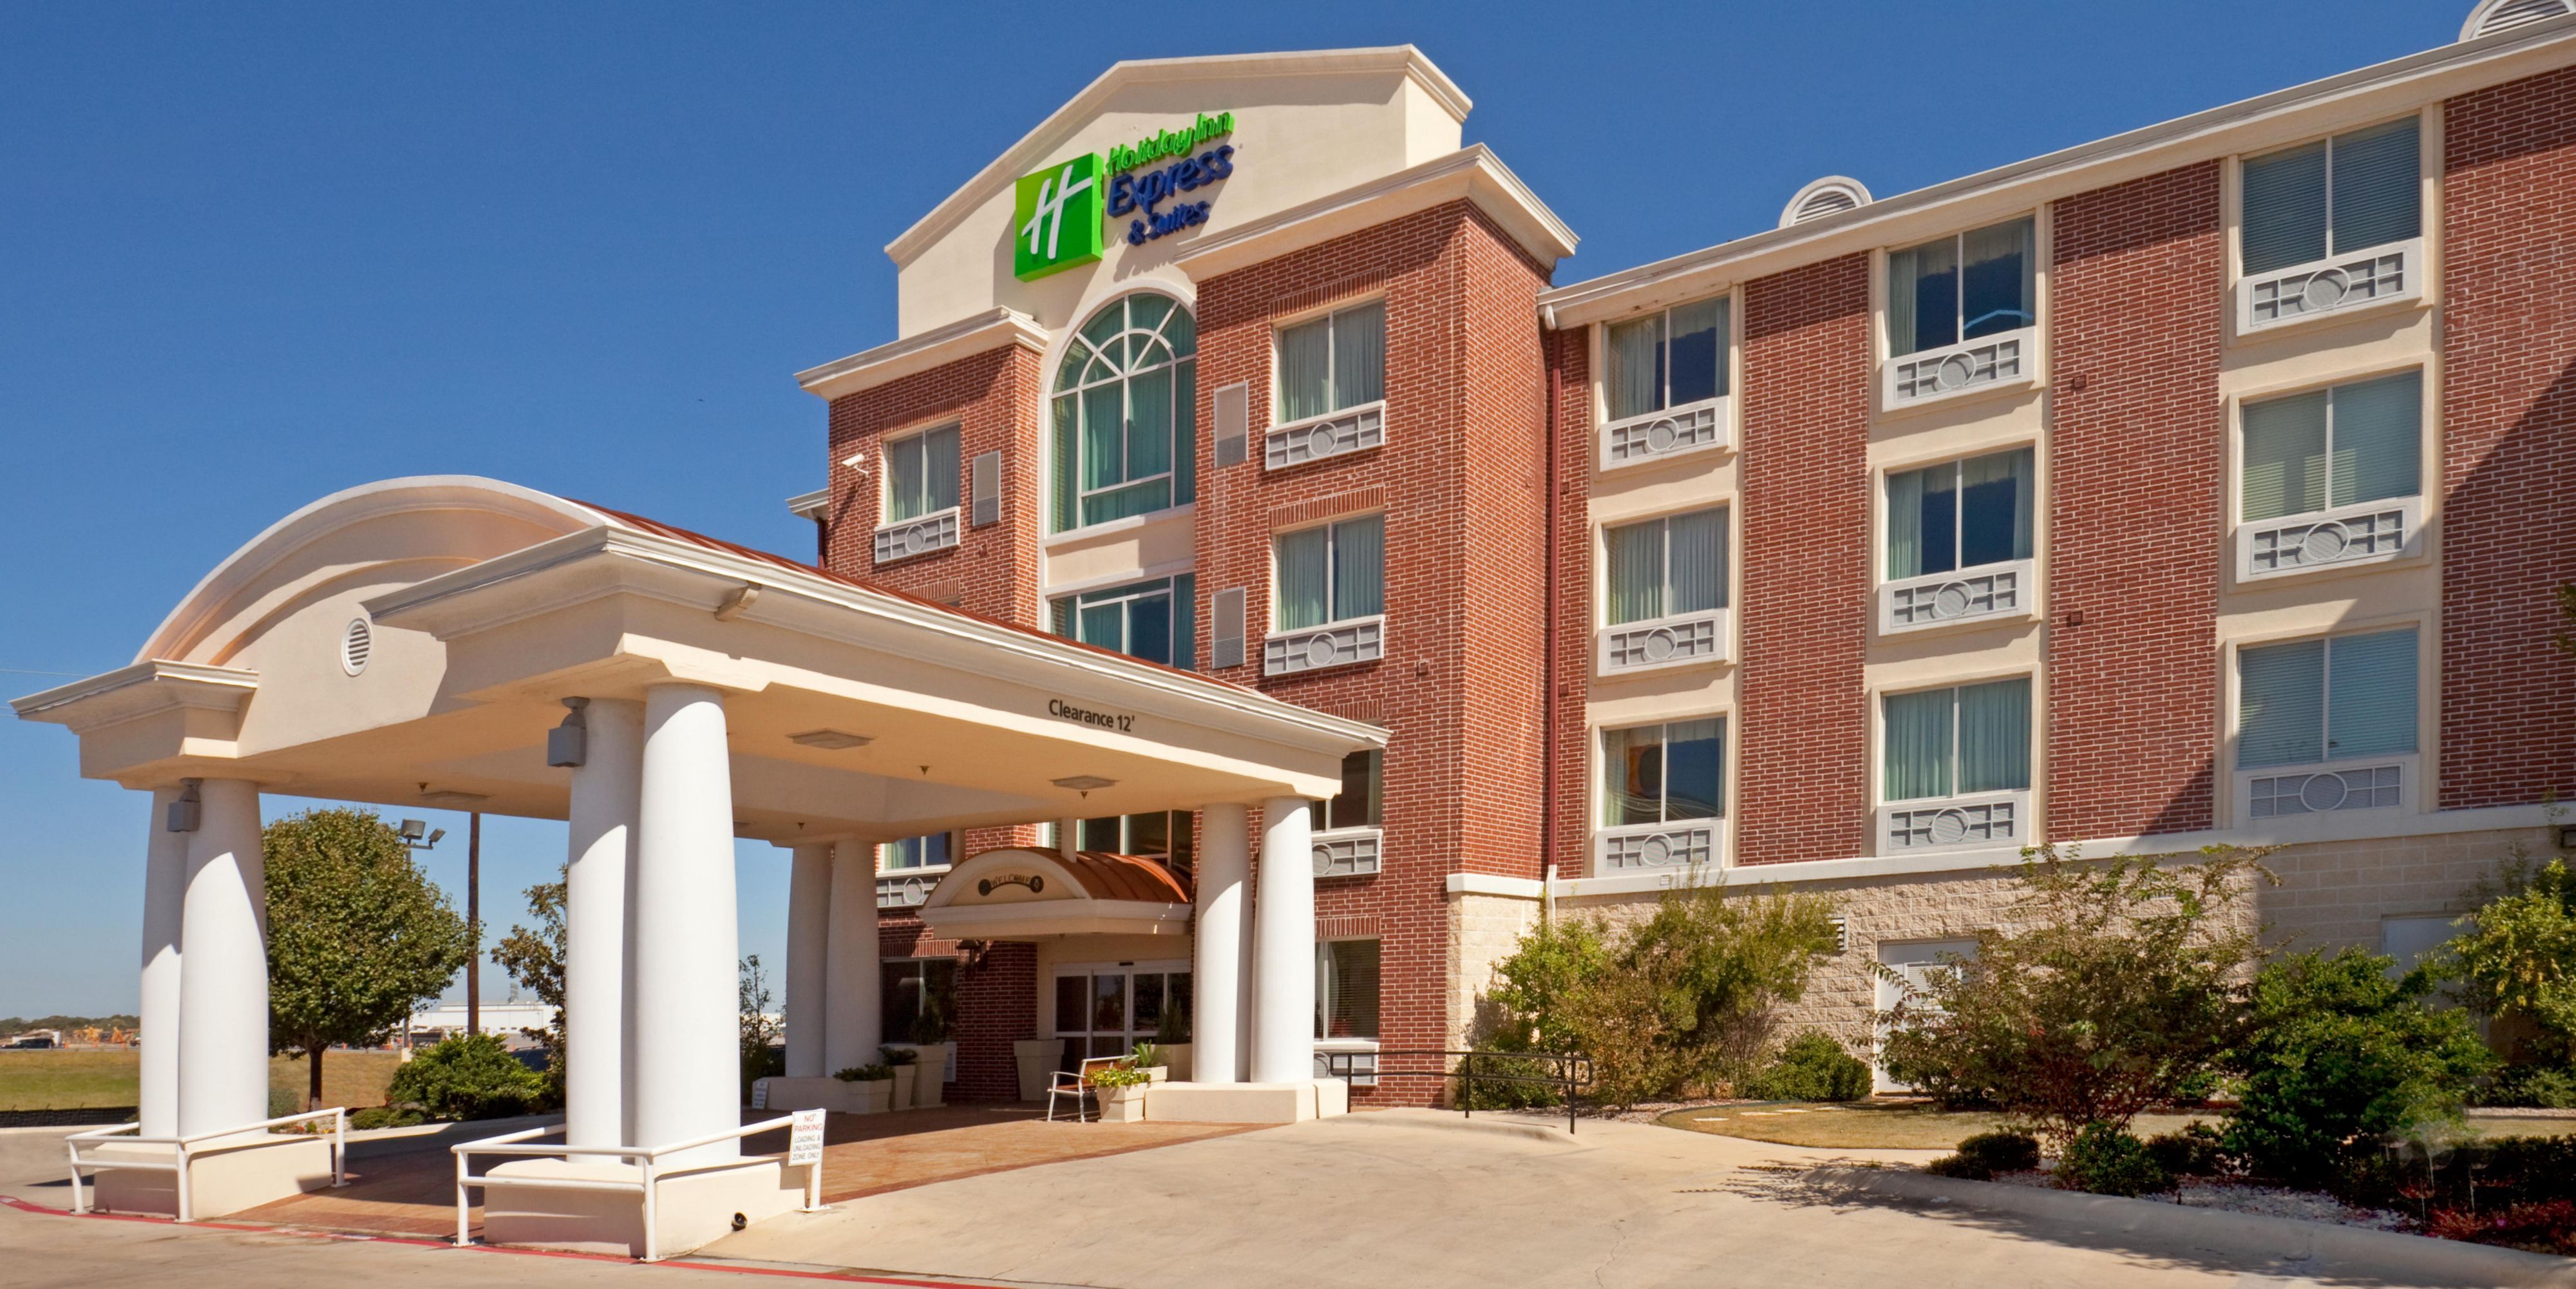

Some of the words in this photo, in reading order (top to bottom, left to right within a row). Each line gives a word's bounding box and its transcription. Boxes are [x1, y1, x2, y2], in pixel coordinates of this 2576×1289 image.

[1106, 128, 1194, 176] Holiday
[1194, 111, 1235, 143] Inn
[1107, 145, 1235, 218] Express
[1021, 164, 1093, 260] H
[1127, 220, 1146, 246] &
[1146, 200, 1211, 242] Suites
[1048, 698, 1113, 729] Clearance
[1117, 715, 1135, 732] 12'
[990, 874, 1032, 888] WELCOME
[794, 1123, 823, 1132] PARKING
[794, 1135, 815, 1143] LOADING
[793, 1143, 821, 1152] UNLOADING
